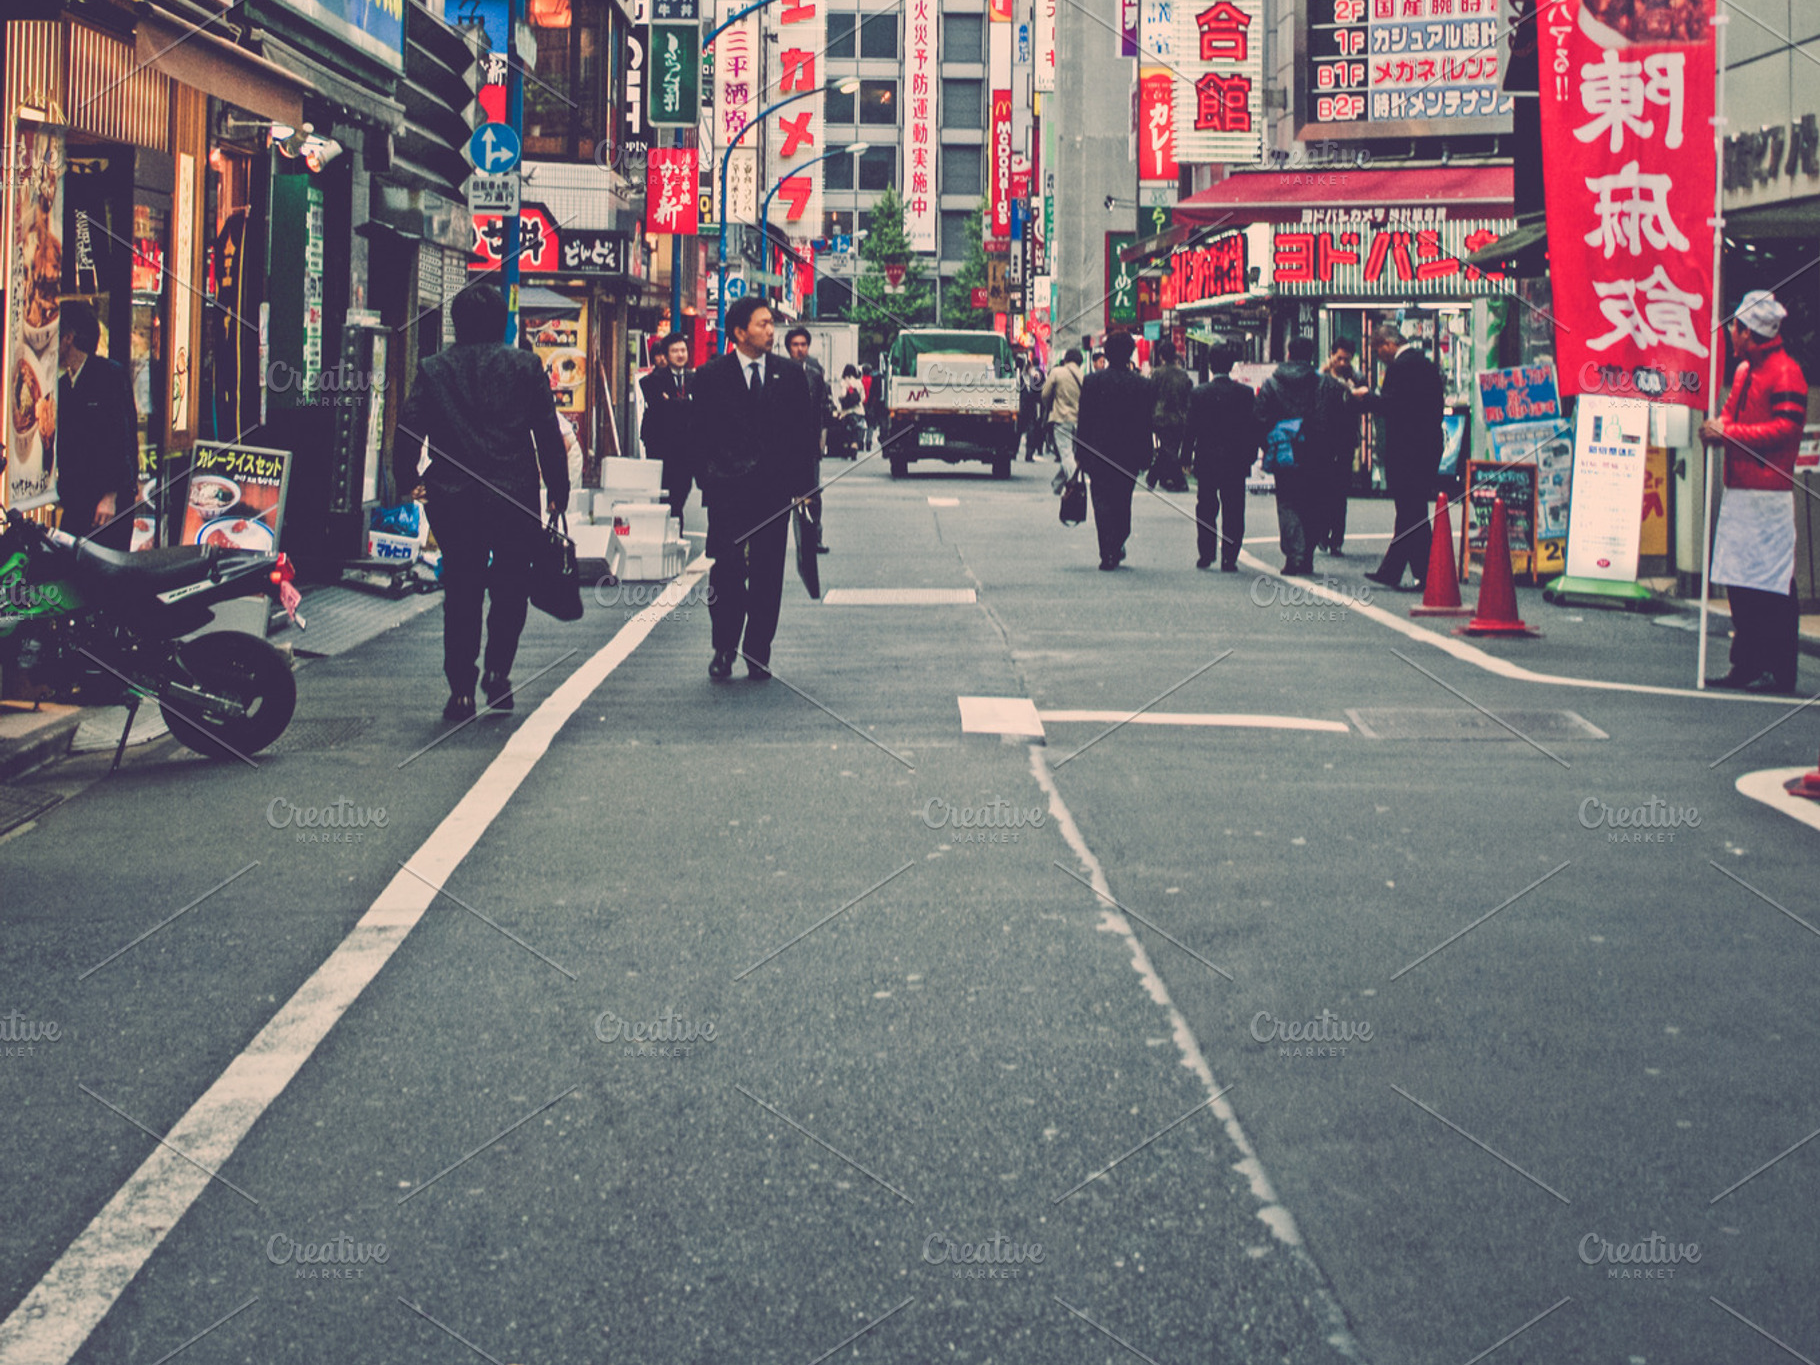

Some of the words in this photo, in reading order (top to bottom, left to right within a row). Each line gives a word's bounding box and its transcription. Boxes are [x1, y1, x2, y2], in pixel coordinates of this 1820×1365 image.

[1334, 29, 1365, 54] 1F
[1317, 60, 1365, 88] B1F
[1317, 95, 1365, 121] B2F
[997, 121, 1011, 225] McDonald's
[564, 241, 616, 268] どんどん
[197, 448, 282, 478] カレーライスセット
